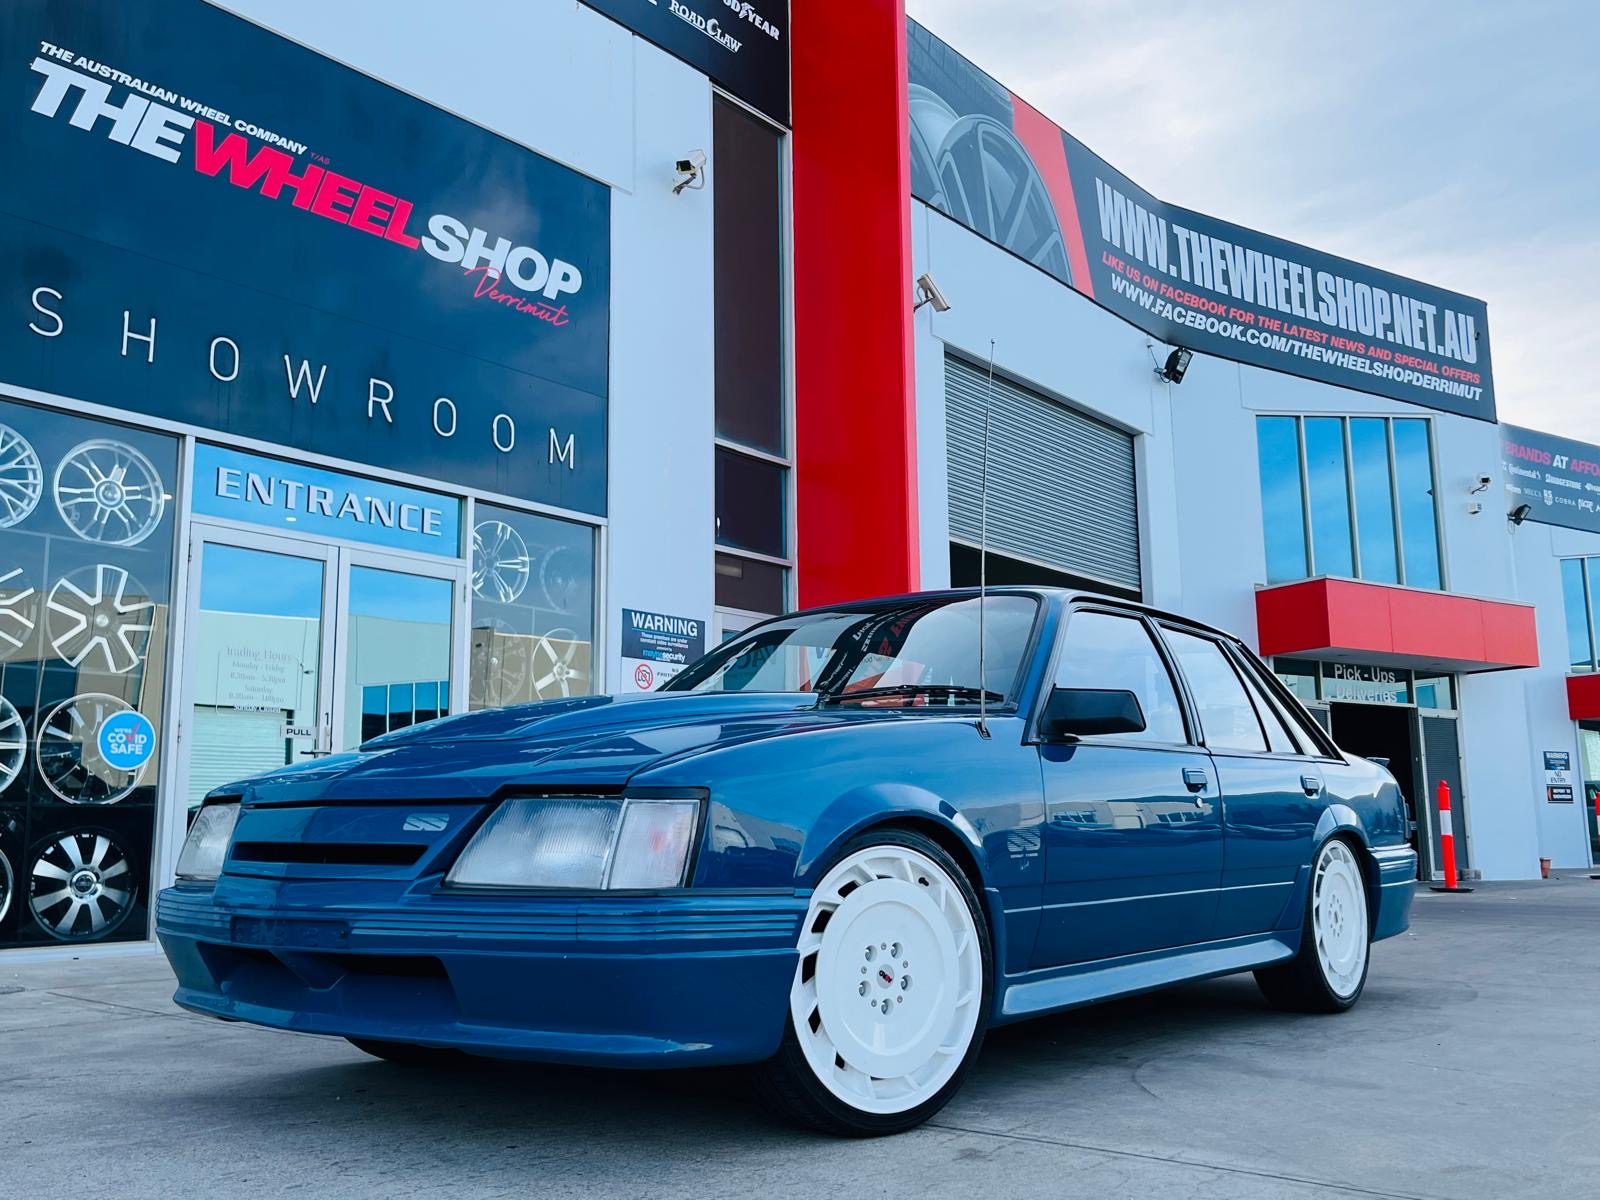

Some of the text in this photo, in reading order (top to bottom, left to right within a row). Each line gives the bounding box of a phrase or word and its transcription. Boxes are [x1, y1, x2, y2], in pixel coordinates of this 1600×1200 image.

[40, 40, 74, 63] THE
[74, 55, 178, 105] AUSTRALIAN
[180, 96, 232, 127] WHEEL
[234, 118, 308, 155] COMPANY
[1096, 177, 1478, 365] WWW.THEWHEELSHOP.NET.AU
[1102, 251, 1481, 384] LIKE US ON FACEBOOK FOR THE LATEST NEWS AND SPECIAL OFFERS
[1111, 272, 1483, 401] WWW.FACEBOOK.COM/THEWHEELSHOPDERRIMUT
[1552, 454, 1569, 469] AT
[216, 467, 442, 536] ENTRANCE
[631, 611, 698, 637] WARNING
[1334, 663, 1361, 682] Pick
[1371, 667, 1396, 687] Ups
[110, 743, 143, 755] SAFE
[286, 728, 311, 737] PULL
